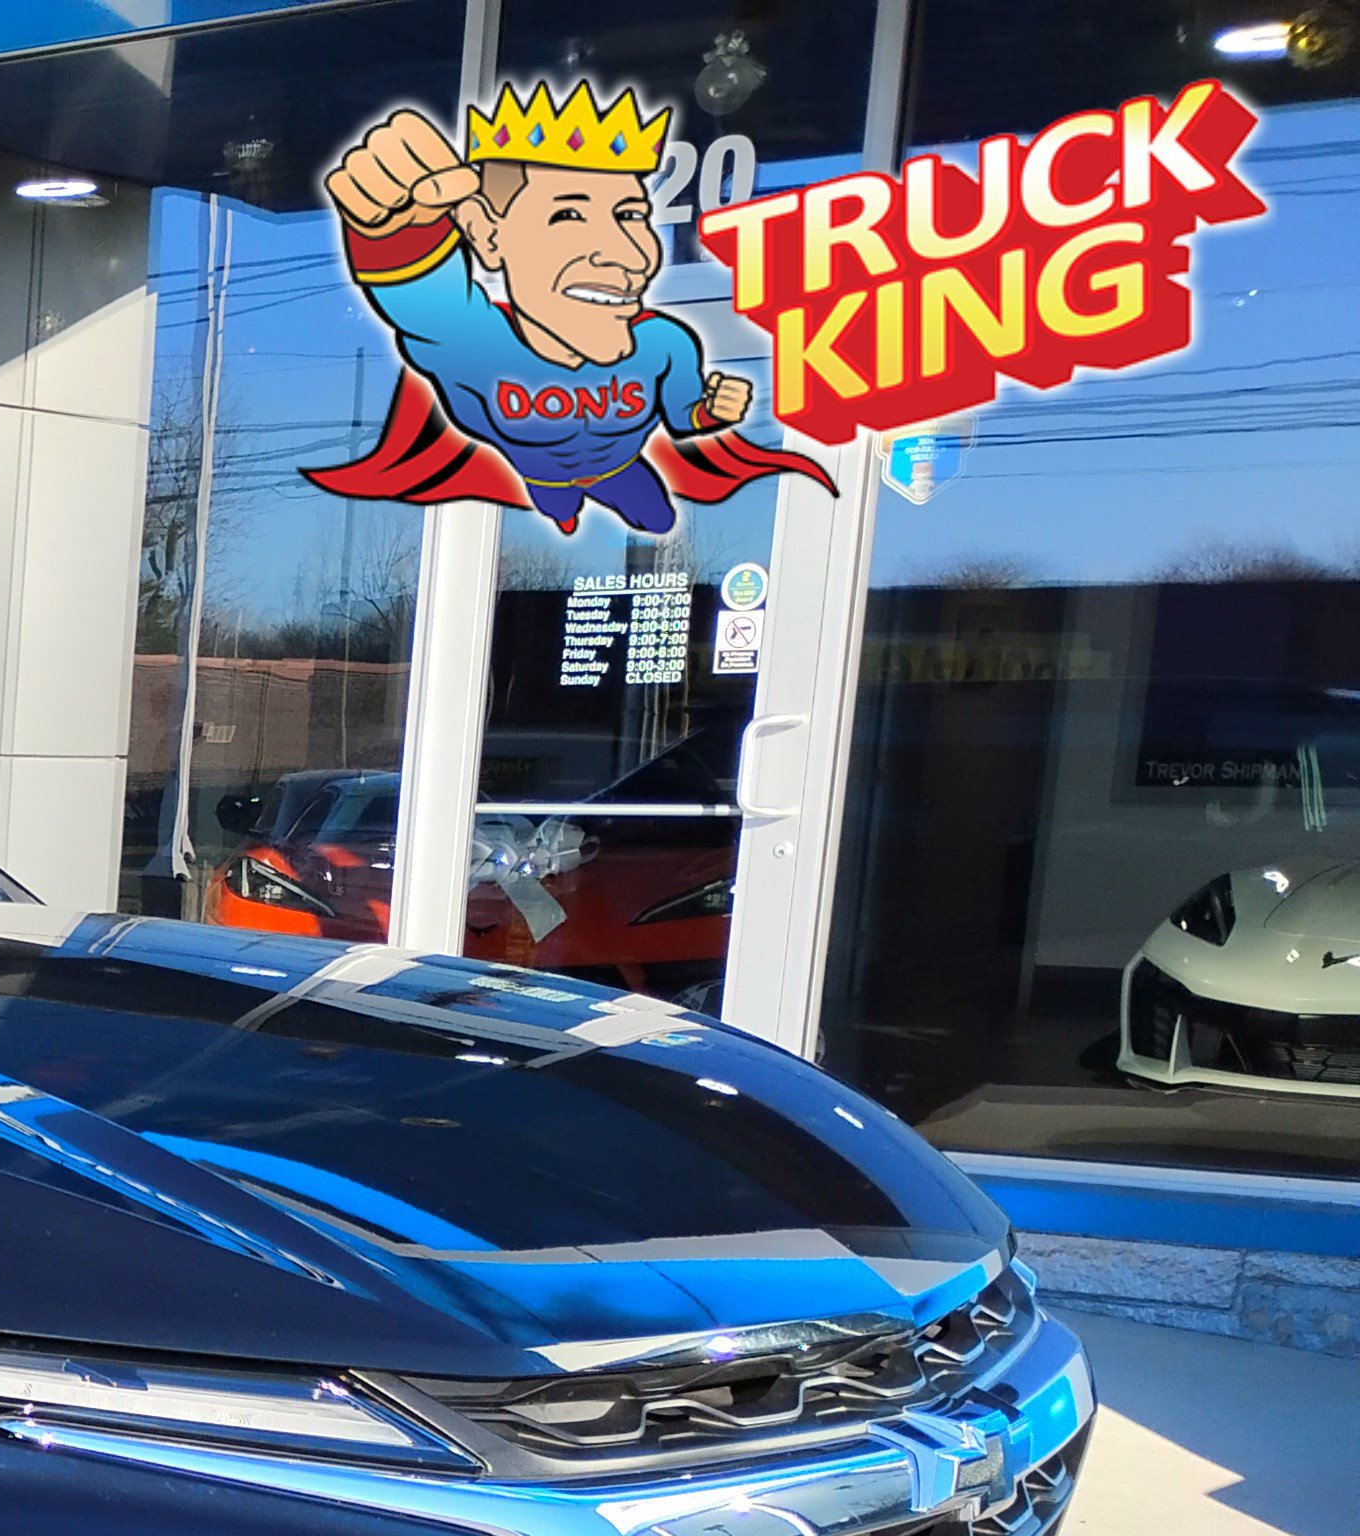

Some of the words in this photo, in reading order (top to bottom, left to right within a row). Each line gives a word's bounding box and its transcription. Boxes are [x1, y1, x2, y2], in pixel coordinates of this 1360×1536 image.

[574, 574, 626, 591] SALES
[630, 572, 688, 589] HOURS
[567, 596, 611, 609] Monday
[566, 609, 610, 622] Tuesday
[565, 621, 628, 634] Wednesday
[564, 635, 614, 648] Thursday
[629, 633, 688, 646] 9:00-7:00
[562, 648, 597, 661] Friday
[561, 661, 609, 674] Saturday
[560, 674, 600, 687] Sunday
[625, 671, 682, 684] CLOSED
[1146, 760, 1216, 779] TREVOR
